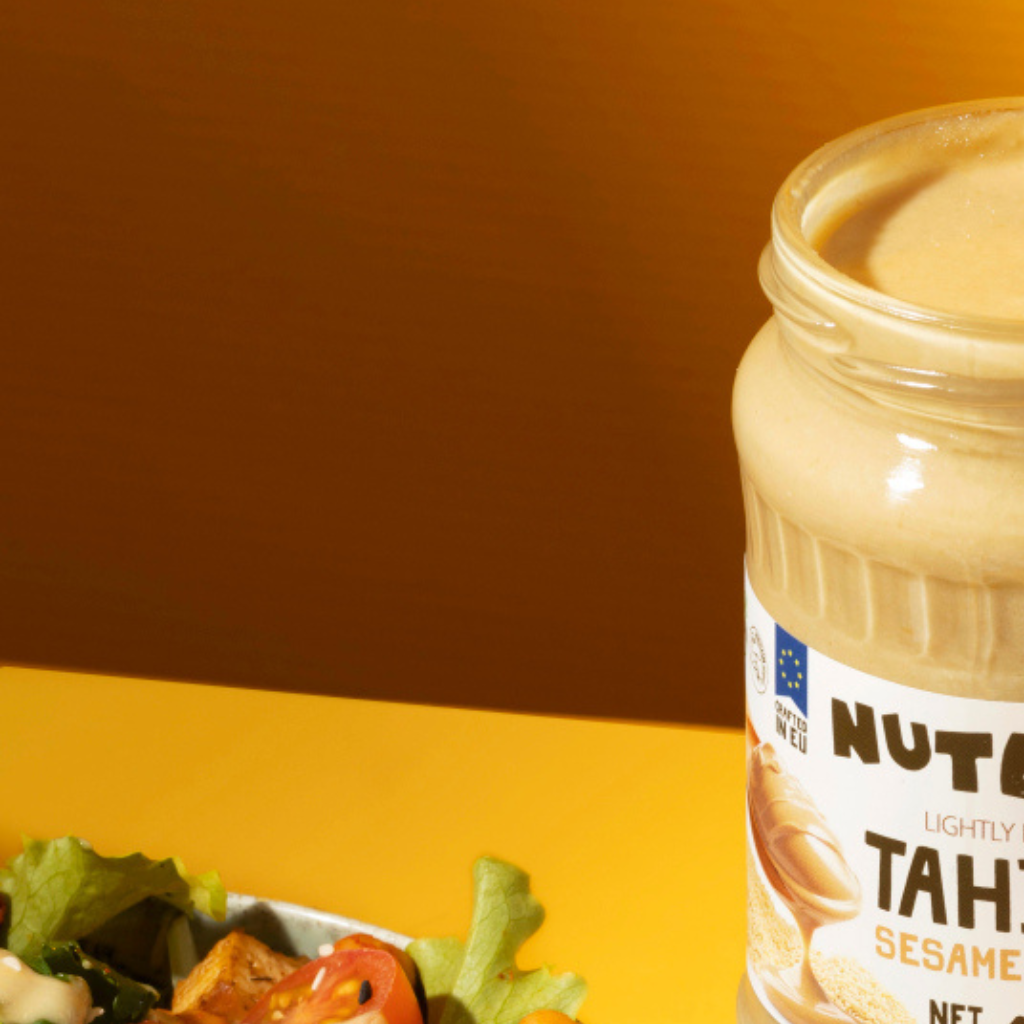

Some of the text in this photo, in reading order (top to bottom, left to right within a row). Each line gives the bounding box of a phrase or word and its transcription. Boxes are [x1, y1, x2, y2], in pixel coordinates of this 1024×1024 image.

[775, 699, 808, 734] CRAFTED
[775, 713, 808, 755] IN EU
[924, 811, 1016, 843] LIGHTLY
[874, 924, 1022, 982] SESAME
